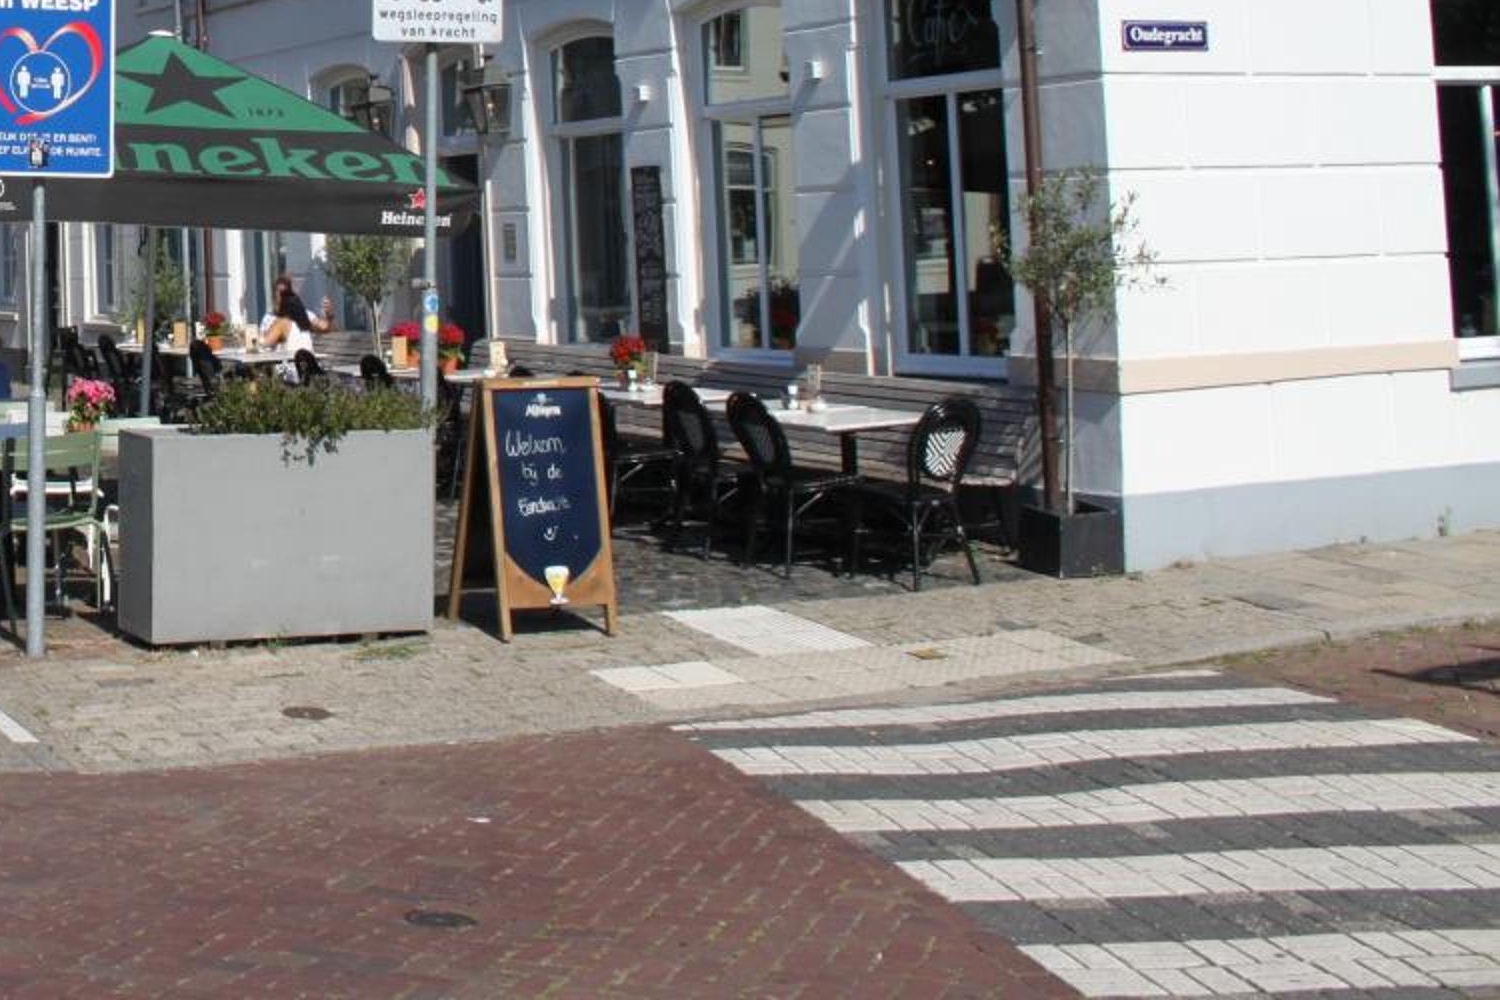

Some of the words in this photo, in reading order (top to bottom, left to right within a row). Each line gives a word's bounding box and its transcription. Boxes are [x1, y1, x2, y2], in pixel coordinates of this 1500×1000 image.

[380, 9, 497, 24] wegsleepregeling
[401, 26, 425, 37] van
[431, 26, 476, 38] kracht
[1130, 26, 1203, 46] Oudegracht
[381, 211, 451, 227] Heineen
[506, 430, 564, 457] Welkom
[547, 463, 563, 479] de
